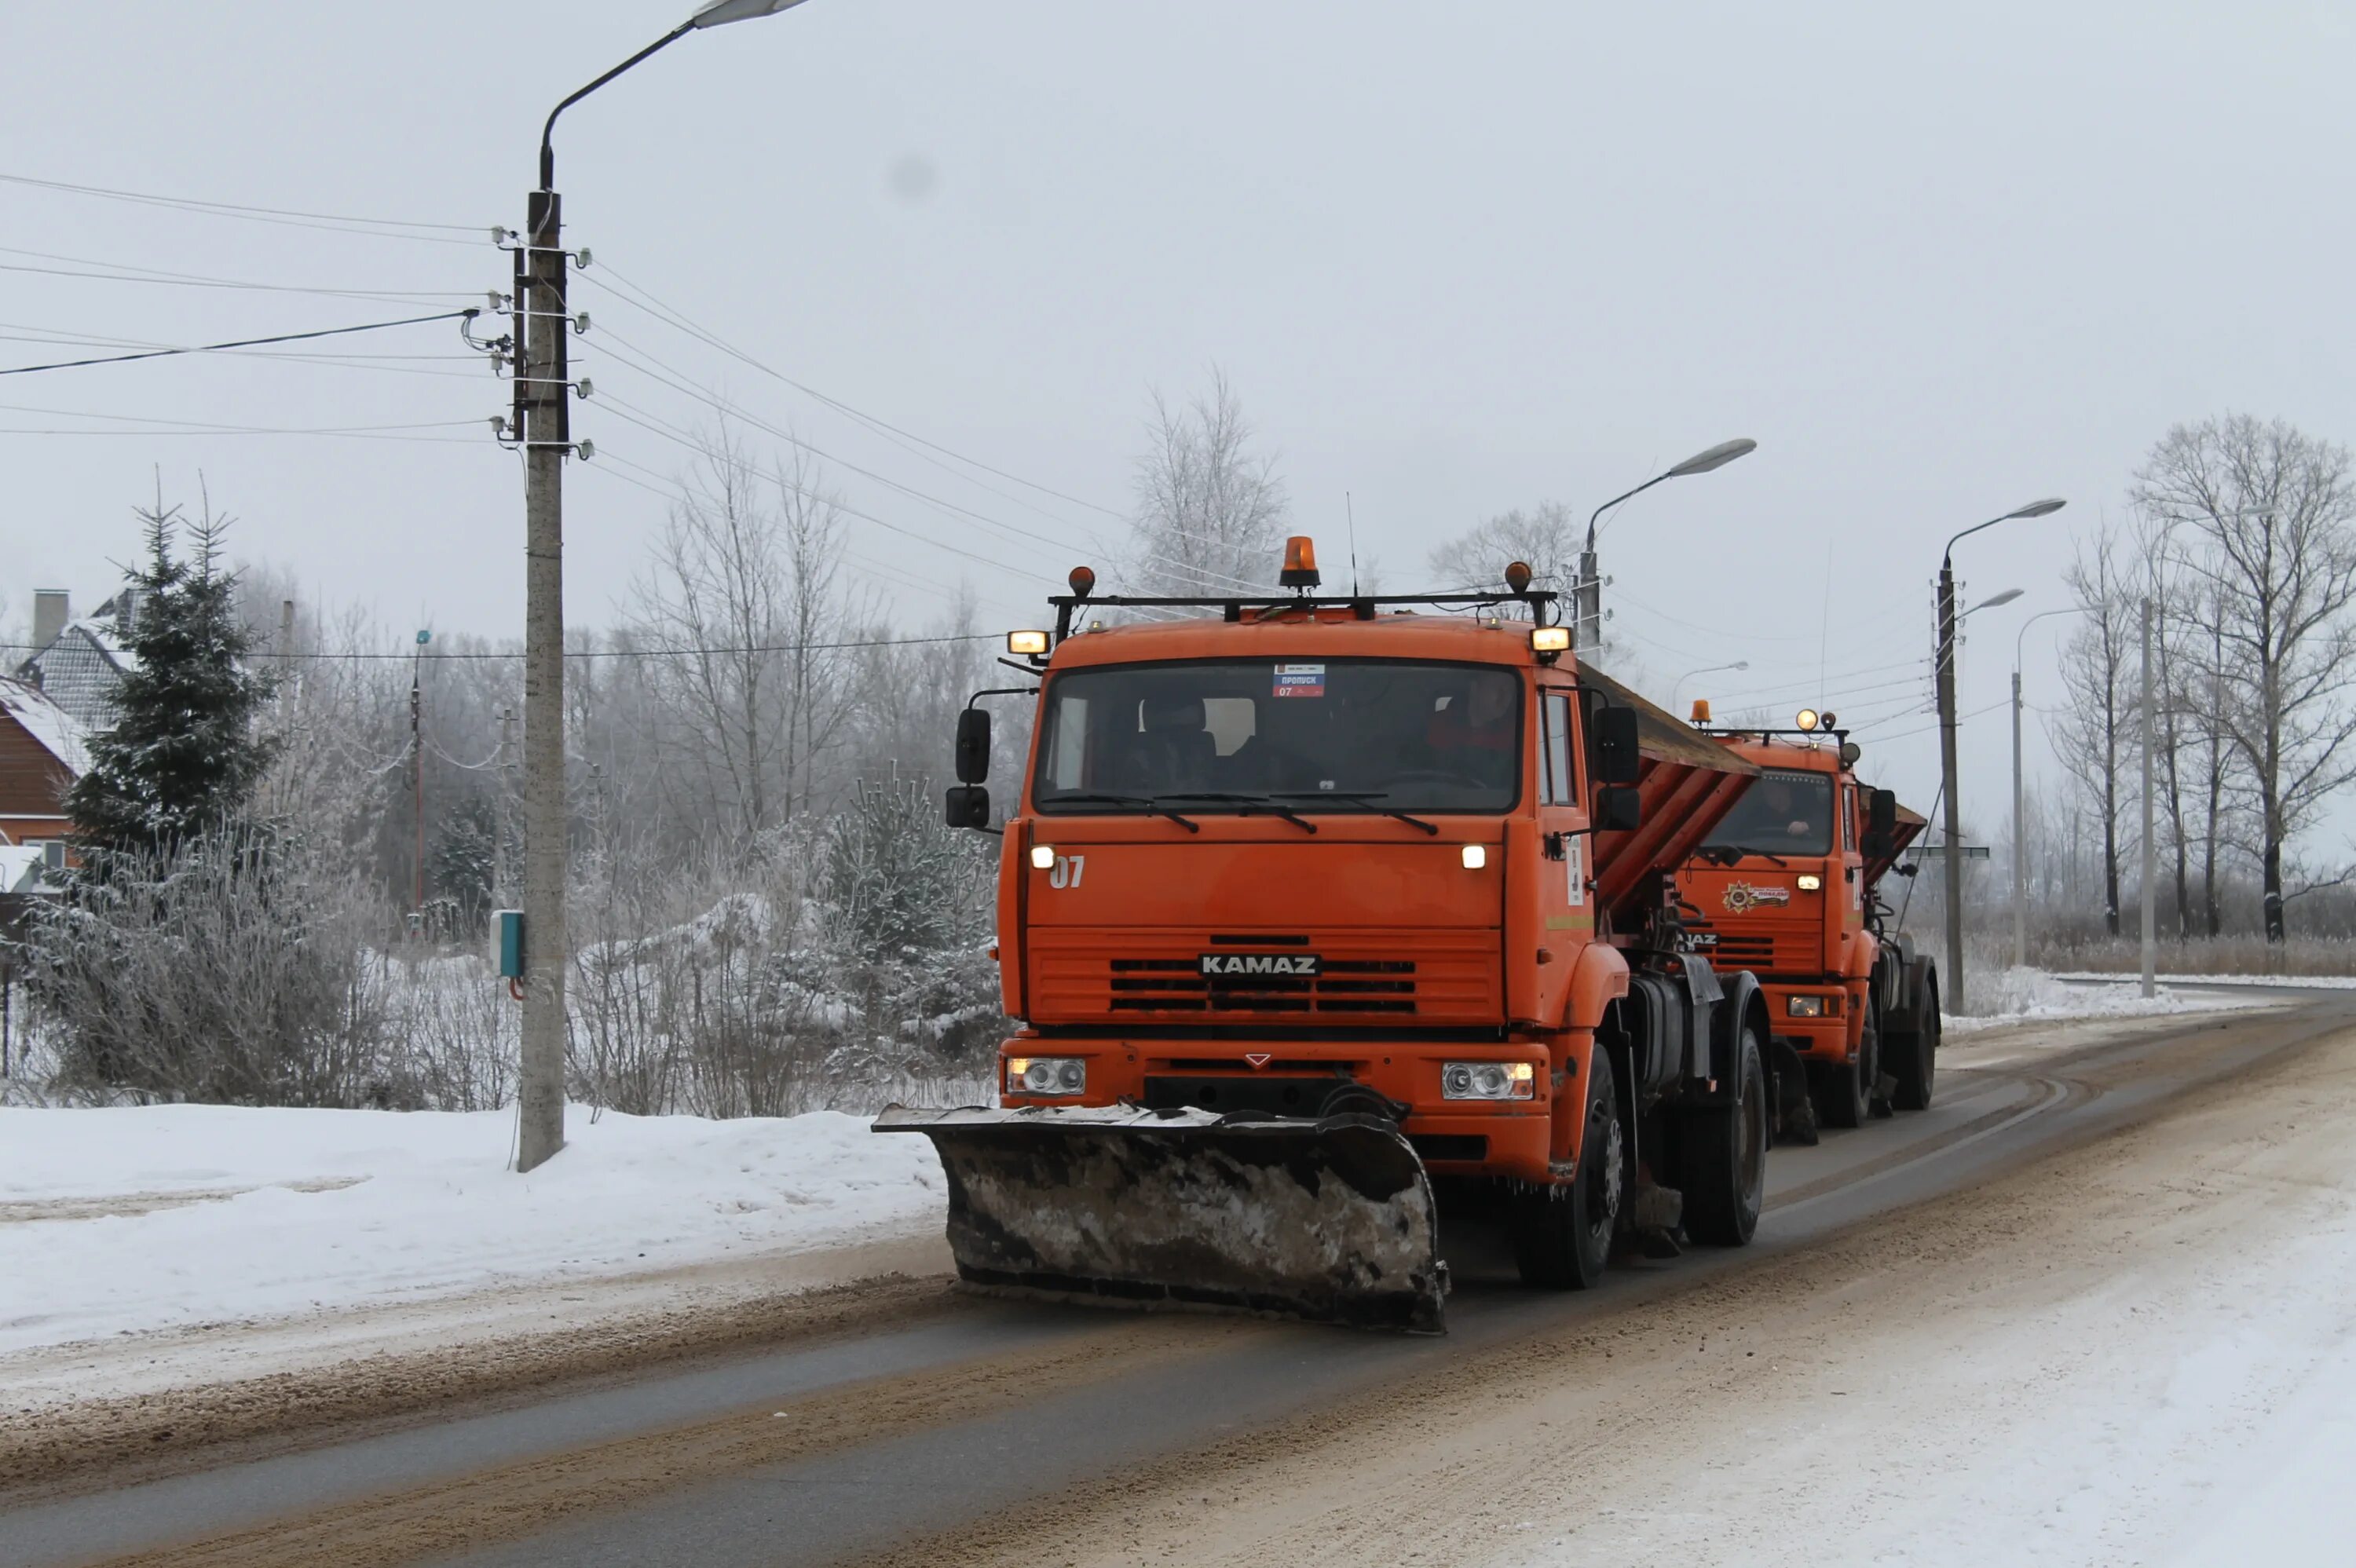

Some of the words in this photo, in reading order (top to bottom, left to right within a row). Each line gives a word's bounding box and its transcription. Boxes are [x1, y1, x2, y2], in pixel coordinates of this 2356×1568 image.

[1282, 676, 1316, 685] ПРОПУСК
[1279, 687, 1292, 696] 07
[1050, 855, 1085, 889] 07
[1202, 956, 1315, 974] KAMAZ
